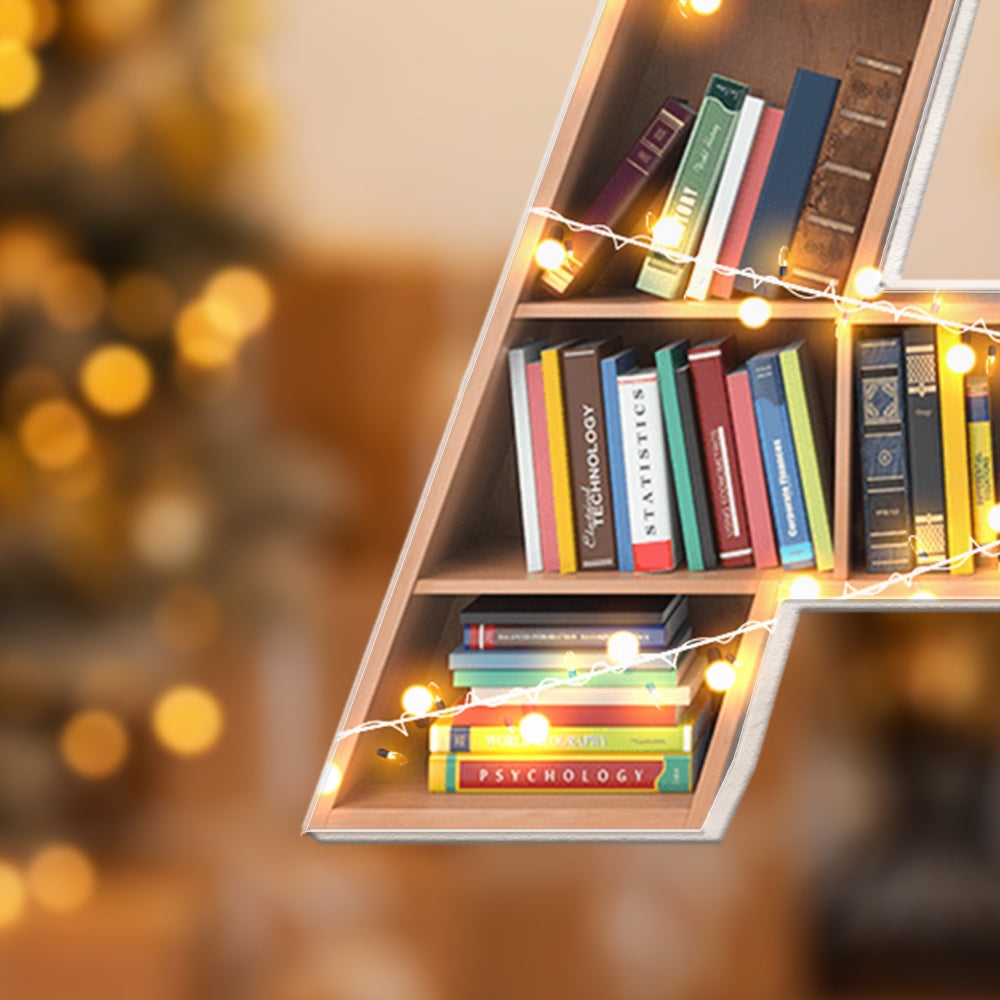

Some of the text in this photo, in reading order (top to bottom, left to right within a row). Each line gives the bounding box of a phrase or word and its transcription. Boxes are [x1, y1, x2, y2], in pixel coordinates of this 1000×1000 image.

[582, 403, 605, 525] TECHNOLOGY
[632, 388, 657, 536] STATISTICS
[478, 768, 644, 784] PSYCHOLOGY
